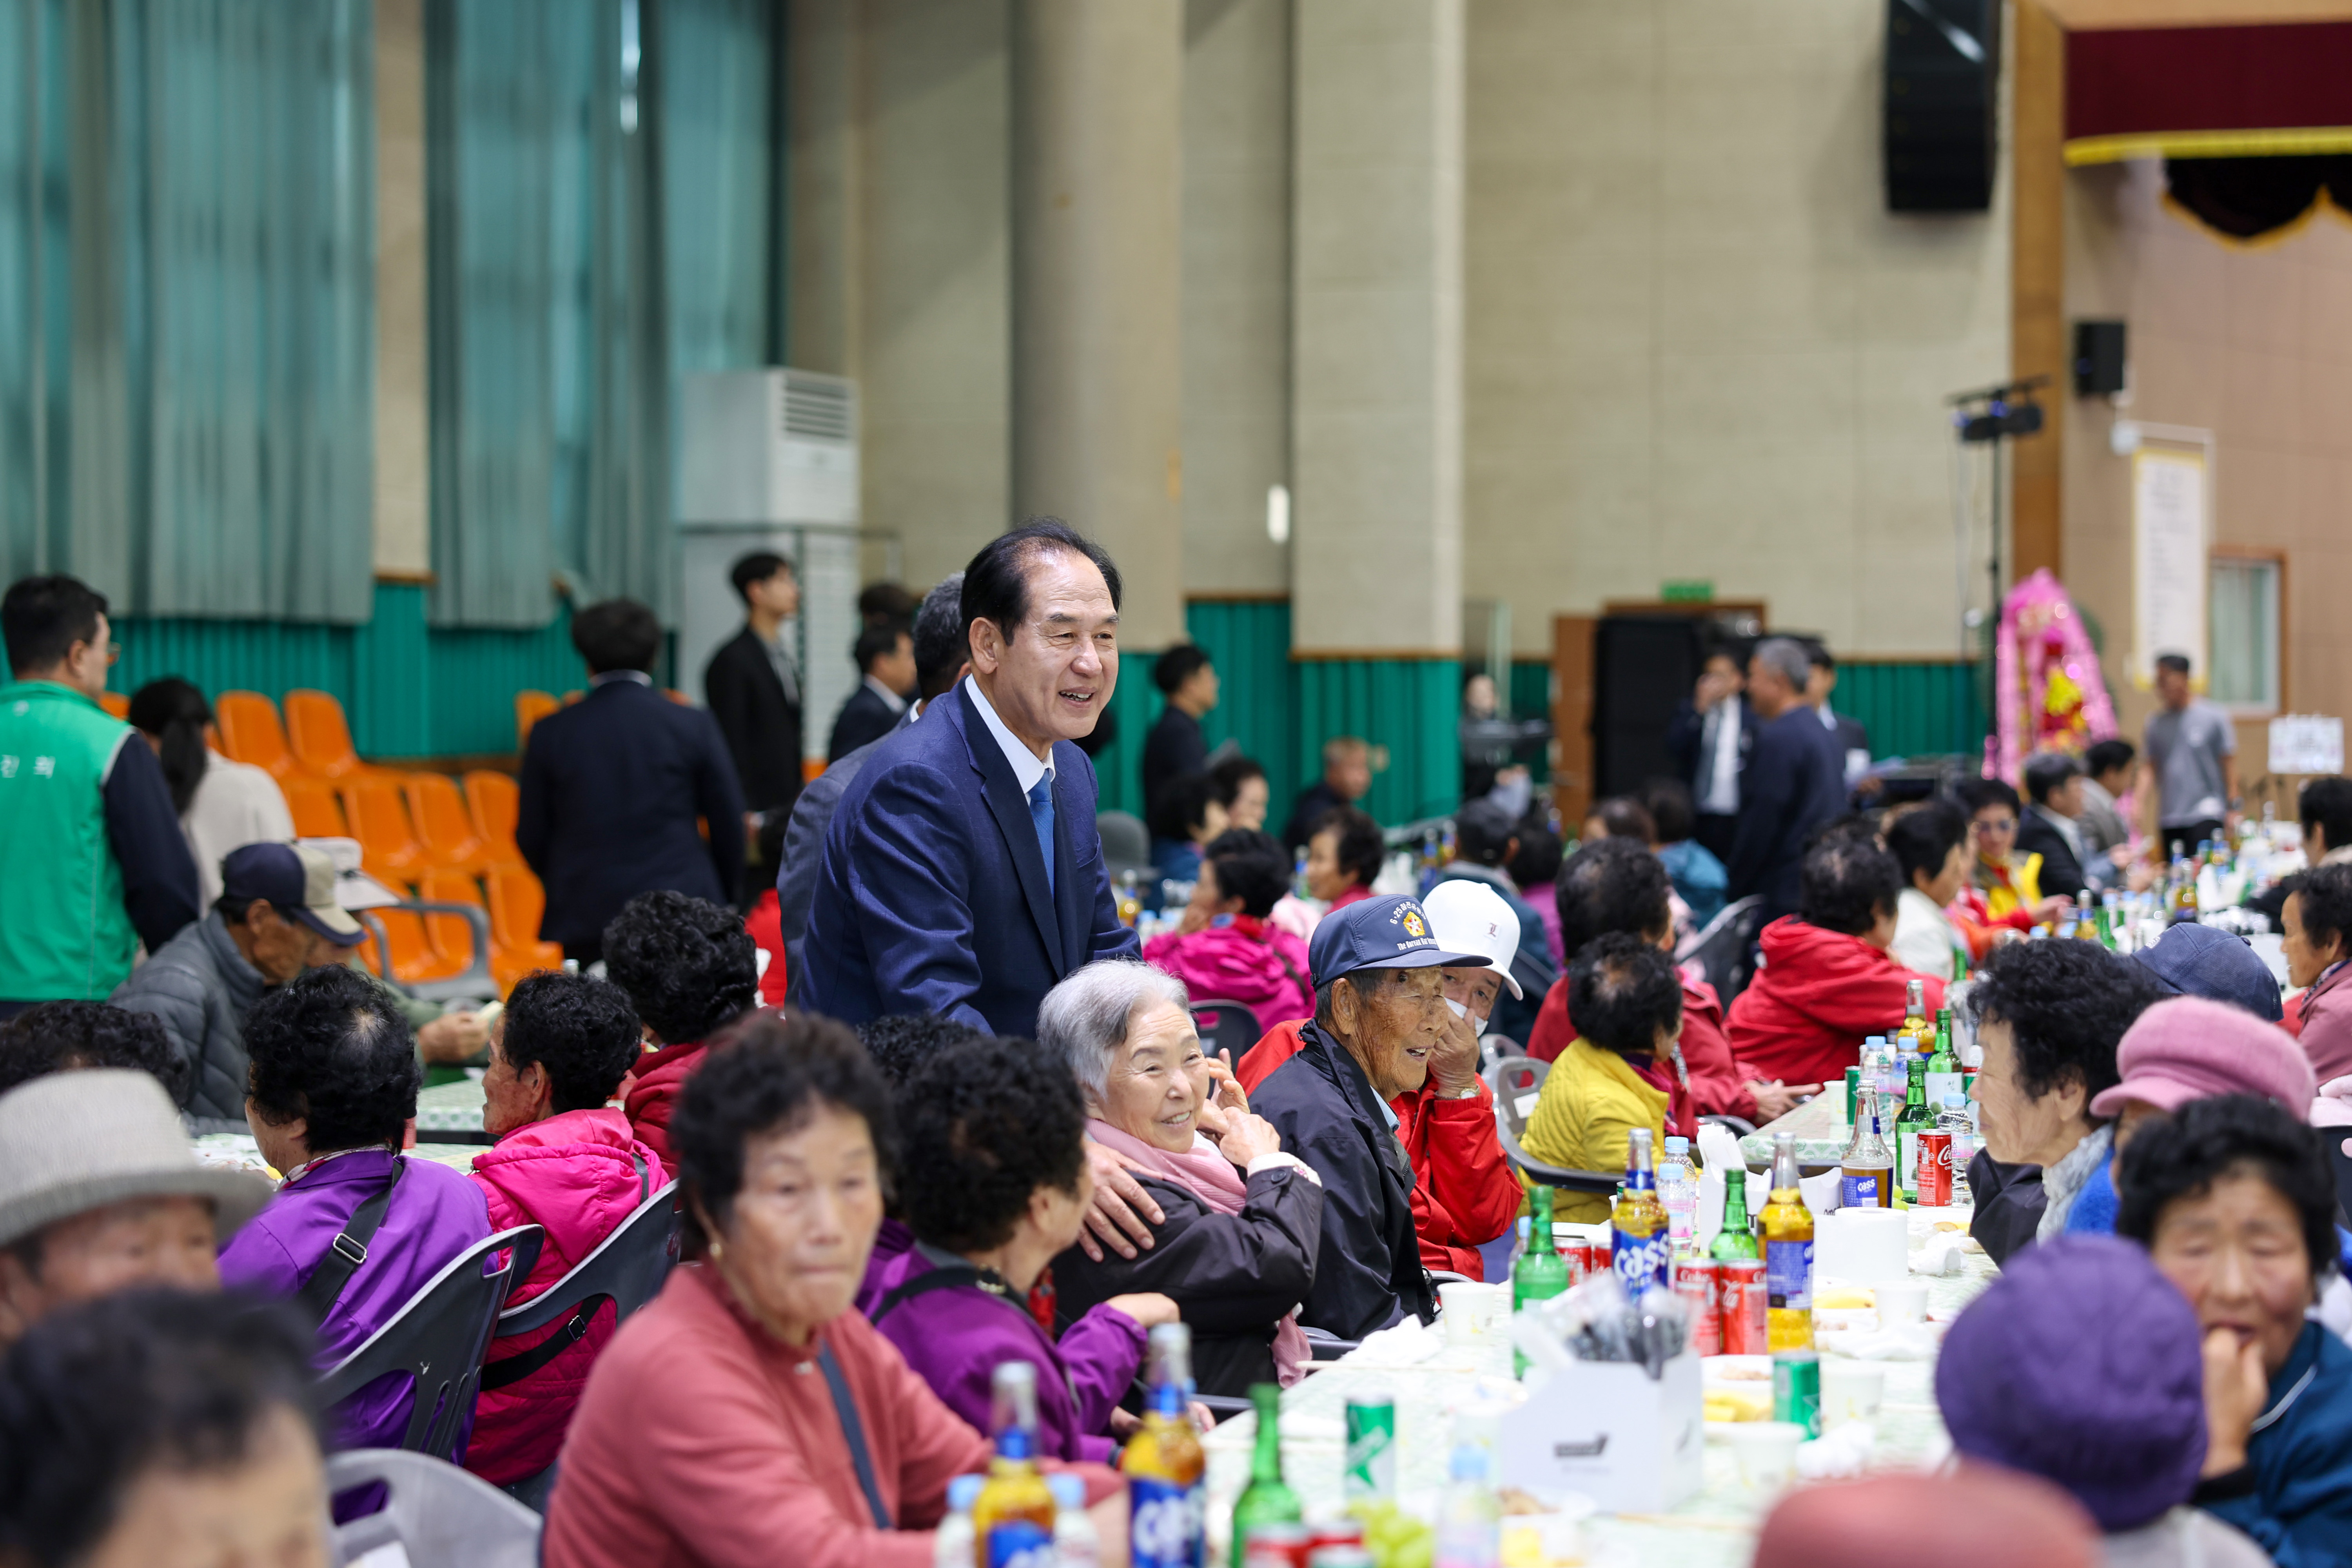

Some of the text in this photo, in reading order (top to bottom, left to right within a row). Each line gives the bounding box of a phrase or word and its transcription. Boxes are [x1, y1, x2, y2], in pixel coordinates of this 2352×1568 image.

[1397, 942, 1407, 951] The
[1405, 939, 1422, 948] Korean
[1680, 1270, 1710, 1283] Coke
